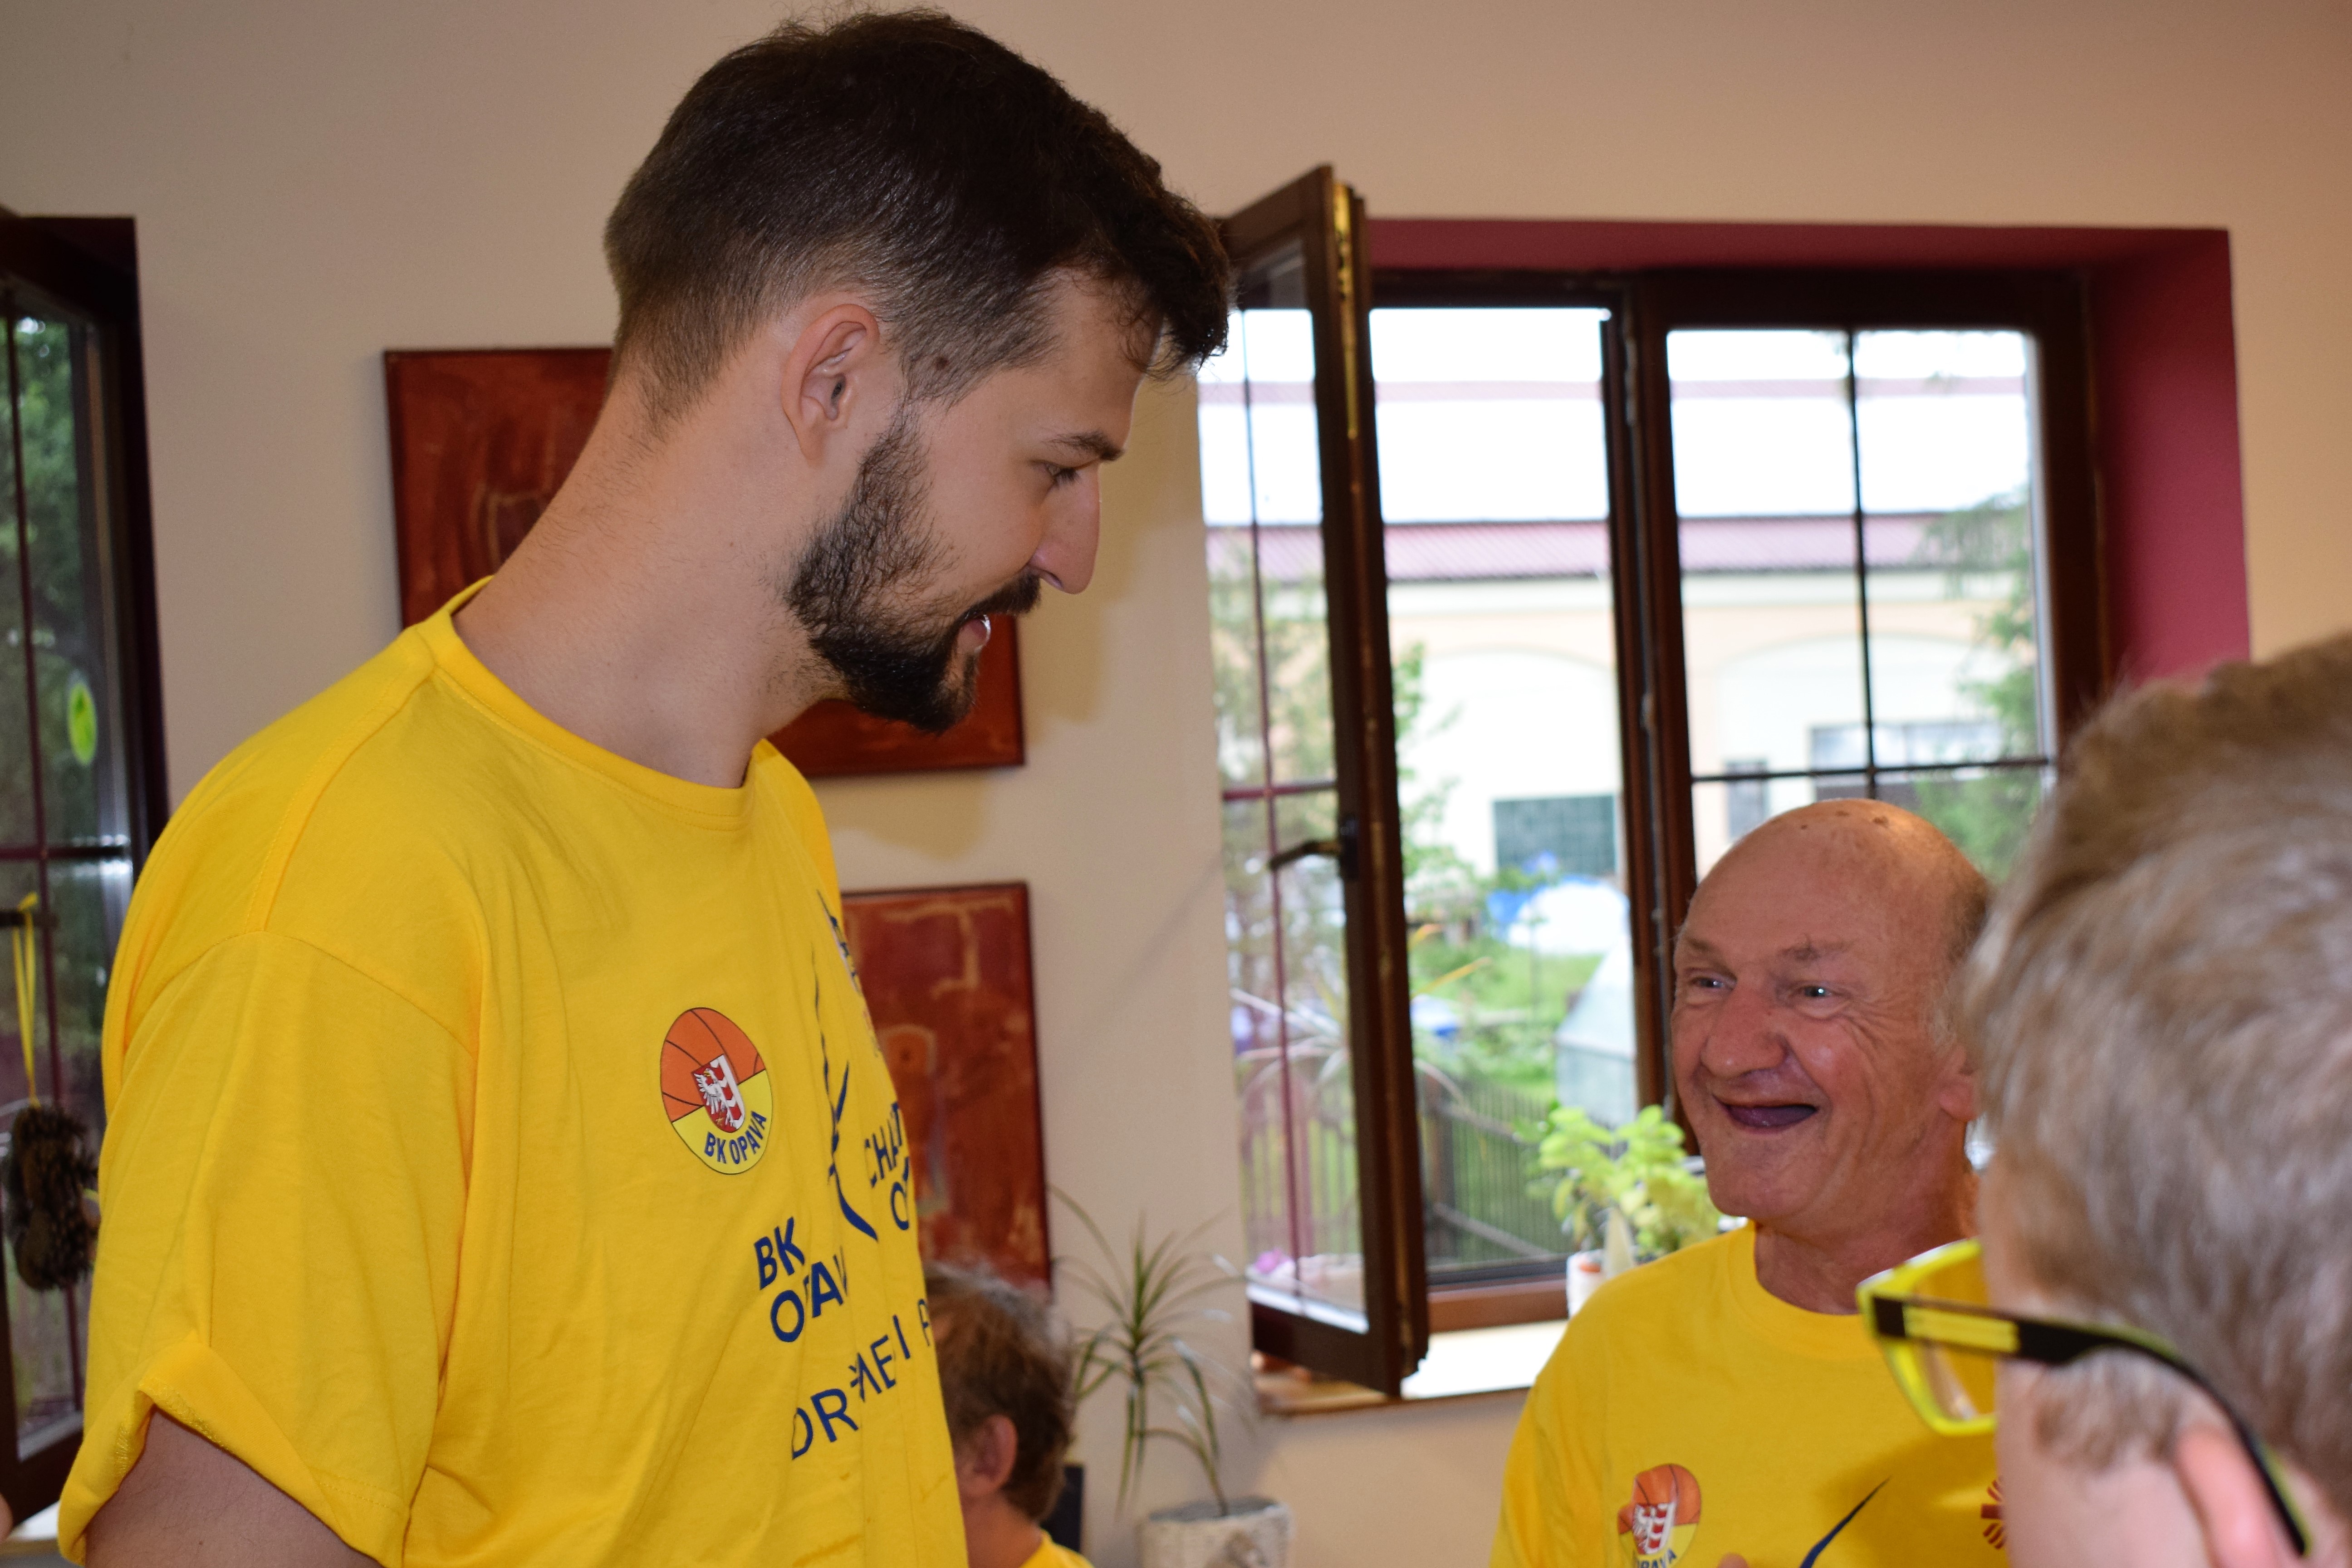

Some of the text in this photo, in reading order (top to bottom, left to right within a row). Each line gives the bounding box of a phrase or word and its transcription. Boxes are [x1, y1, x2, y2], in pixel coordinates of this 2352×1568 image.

[705, 1111, 767, 1164] BK OPAVA
[754, 1216, 805, 1290] BK
